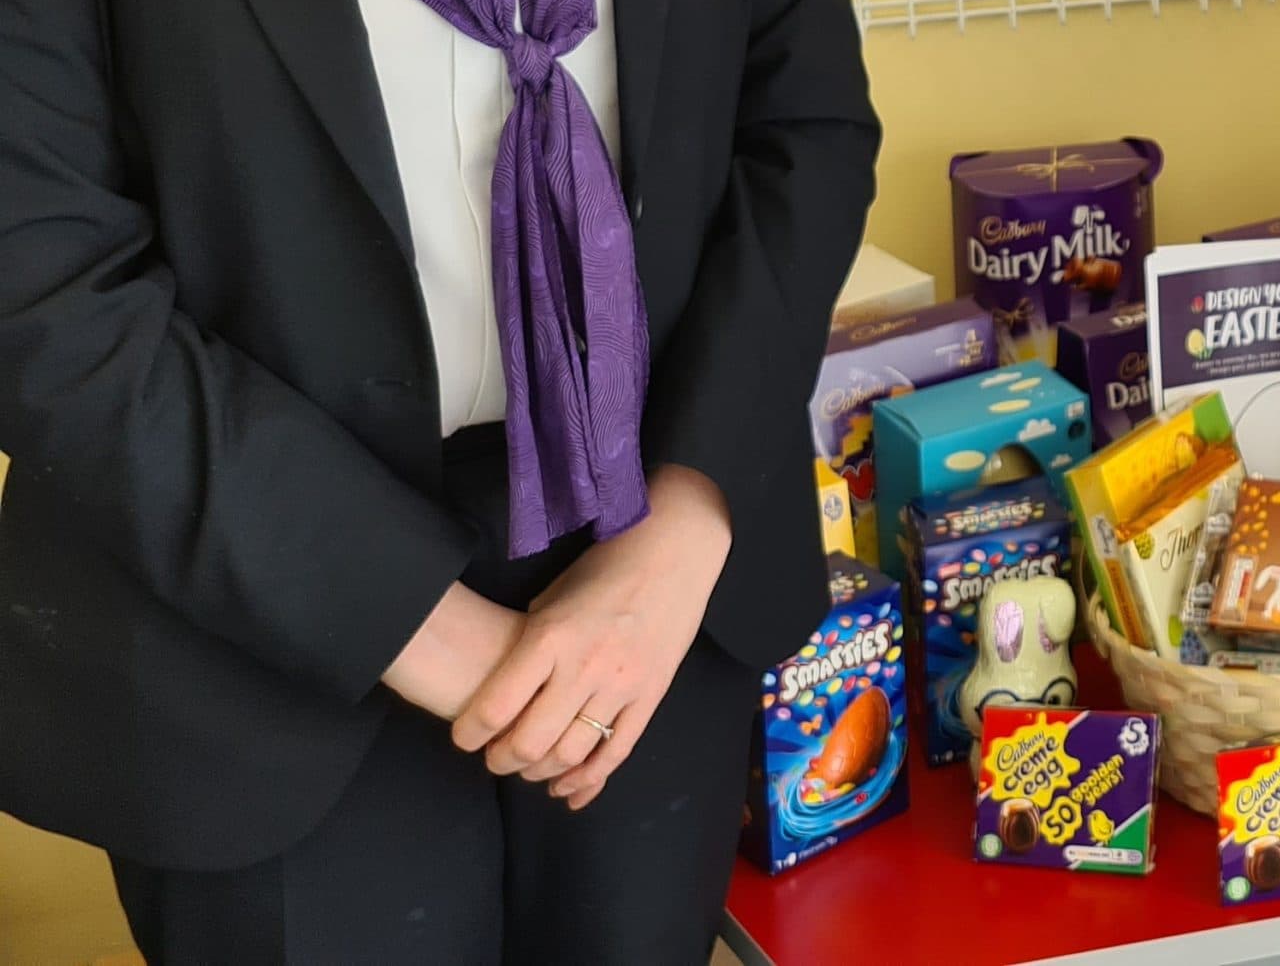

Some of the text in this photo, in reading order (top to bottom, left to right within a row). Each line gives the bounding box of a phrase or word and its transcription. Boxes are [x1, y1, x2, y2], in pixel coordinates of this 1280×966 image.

[967, 218, 1128, 285] Dairy Milk
[980, 217, 1048, 246] Cadbury
[1204, 286, 1261, 312] DESIGN
[996, 730, 1046, 773] Cadbury
[1003, 735, 1060, 792] creme
[1023, 756, 1065, 797] egg
[1046, 803, 1076, 838] 50
